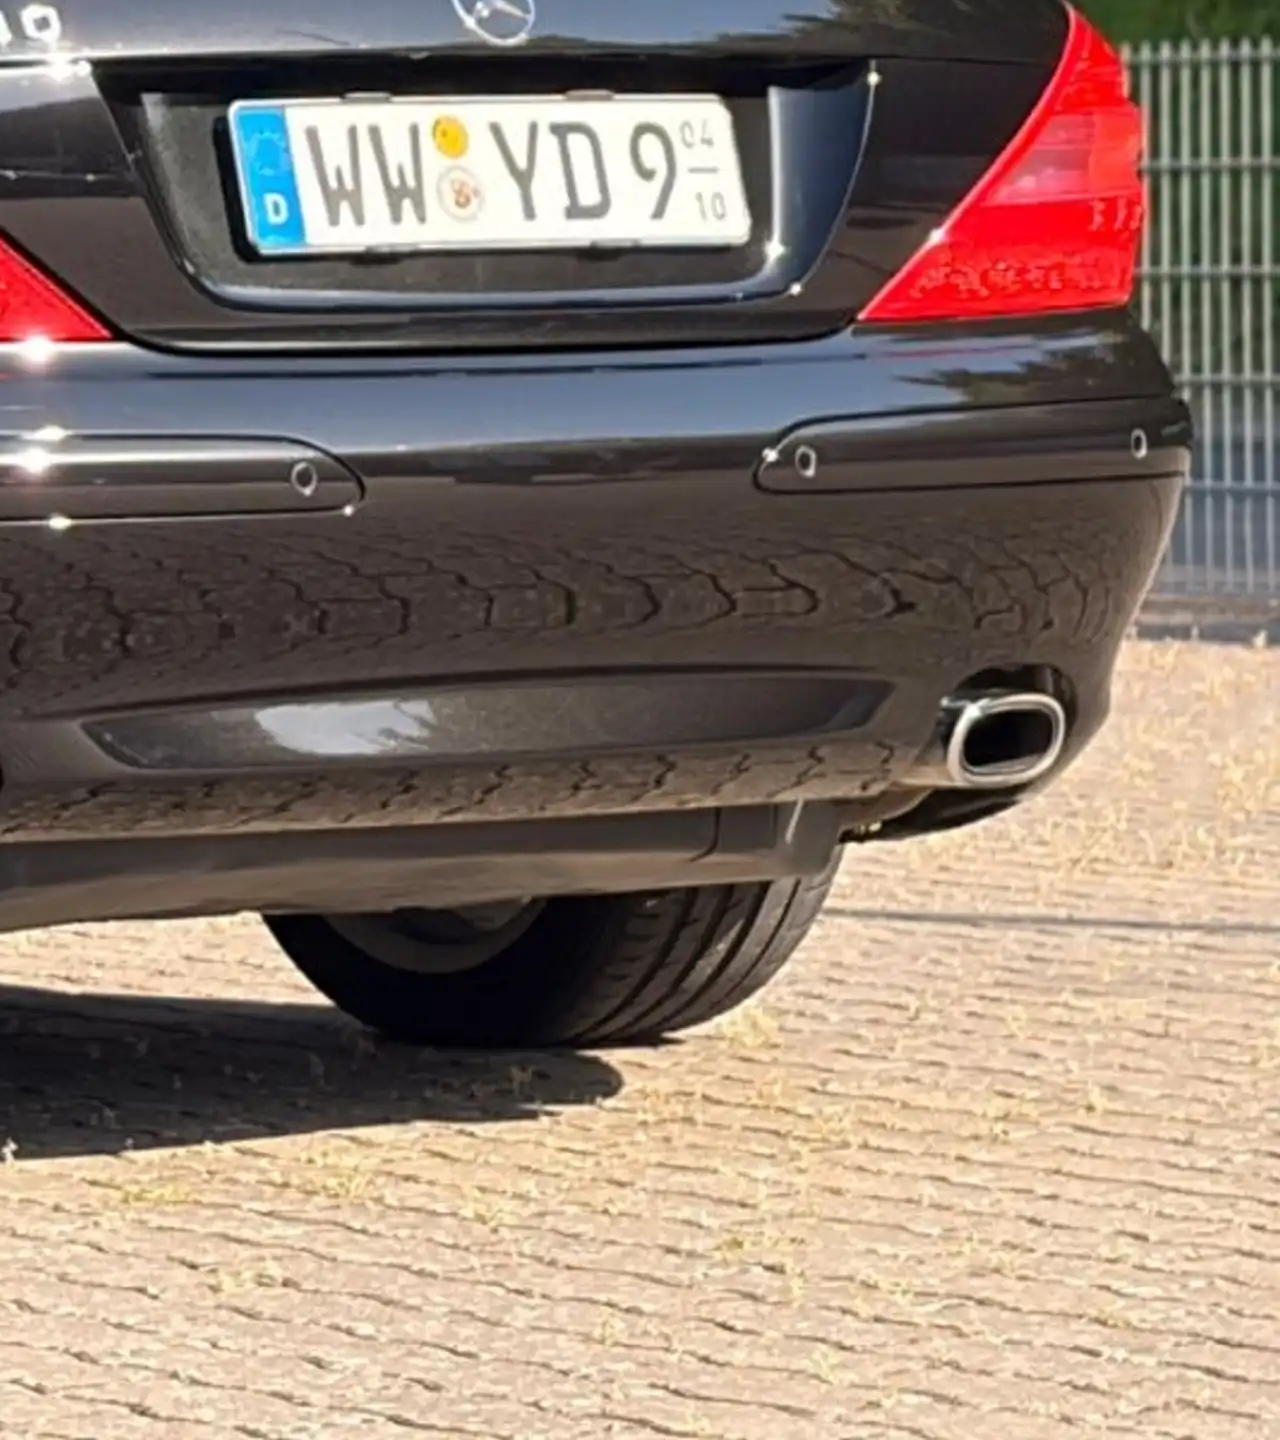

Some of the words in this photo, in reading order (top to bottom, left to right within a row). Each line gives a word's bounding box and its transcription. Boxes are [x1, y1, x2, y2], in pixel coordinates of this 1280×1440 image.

[304, 122, 427, 227] WW
[488, 120, 612, 222] YD
[629, 121, 677, 221] 9
[264, 193, 289, 225] D
[695, 191, 727, 222] 10
